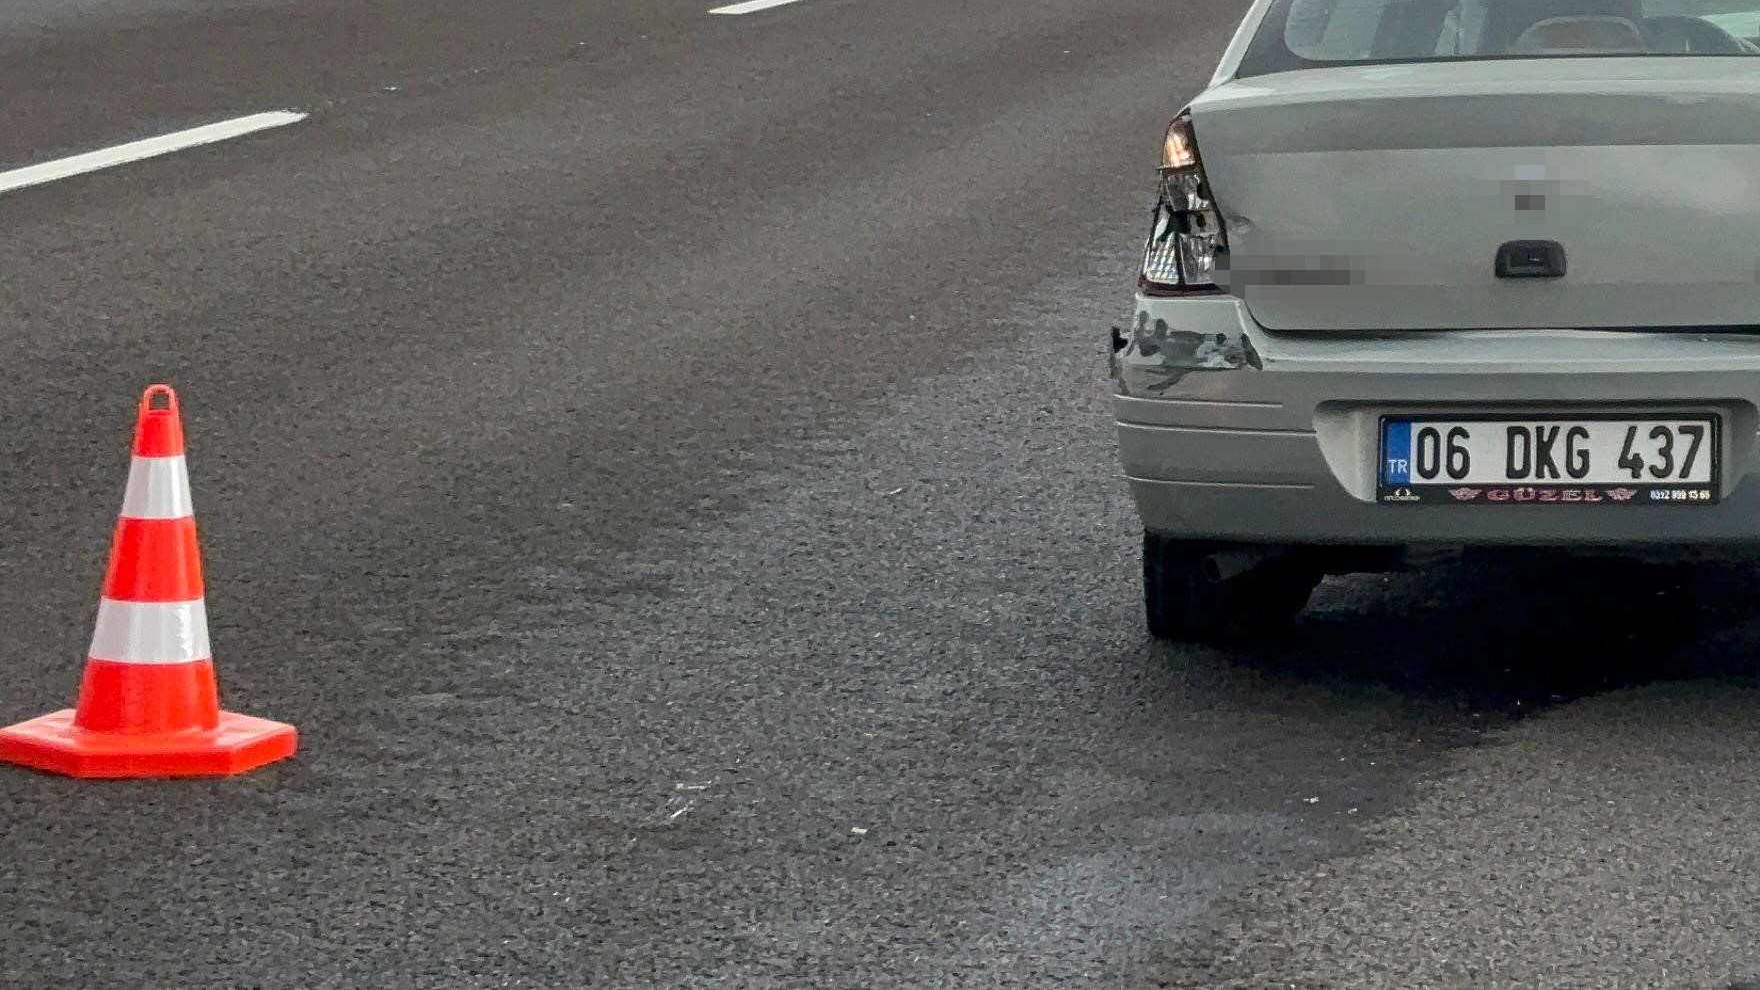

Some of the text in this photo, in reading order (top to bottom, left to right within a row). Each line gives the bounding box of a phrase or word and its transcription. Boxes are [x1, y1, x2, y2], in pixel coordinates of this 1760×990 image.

[1388, 458, 1408, 475] TR
[1417, 425, 1704, 480] 06 DKG 437
